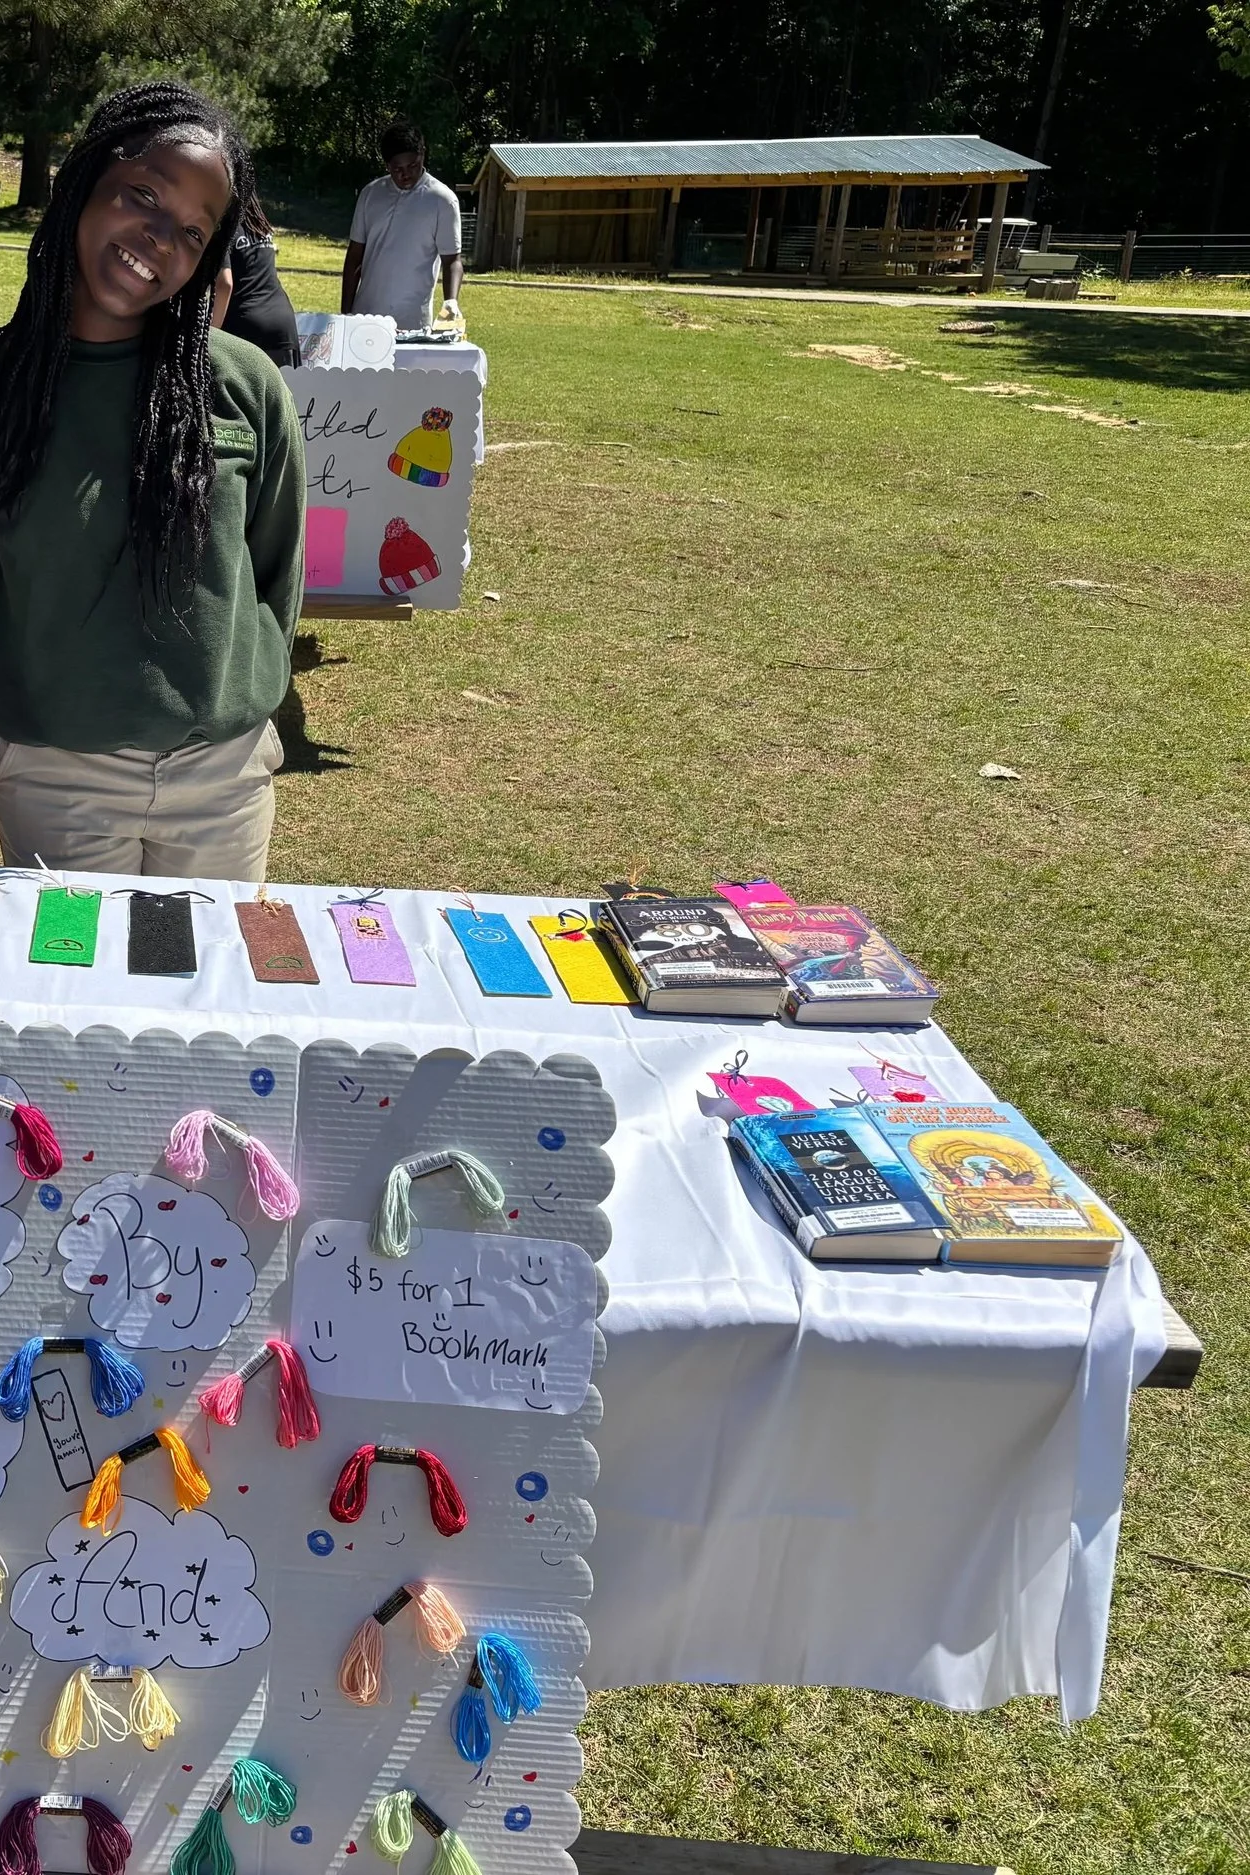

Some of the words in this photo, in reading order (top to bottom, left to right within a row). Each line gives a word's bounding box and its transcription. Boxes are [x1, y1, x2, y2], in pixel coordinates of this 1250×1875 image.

[214, 427, 254, 442] bertas
[639, 909, 707, 918] AROUND
[654, 922, 713, 938] 80
[791, 1132, 837, 1144] JULES
[791, 1138, 848, 1150] VERNE
[809, 1168, 878, 1181] 20,000
[814, 1176, 884, 1189] LEAGUES
[820, 1184, 890, 1197] UNDER
[824, 1194, 859, 1204] THE
[865, 1192, 897, 1201] SEA
[346, 1257, 384, 1294] $5
[398, 1269, 440, 1304] for
[452, 1277, 485, 1307] 1
[51, 1530, 210, 1628] And
